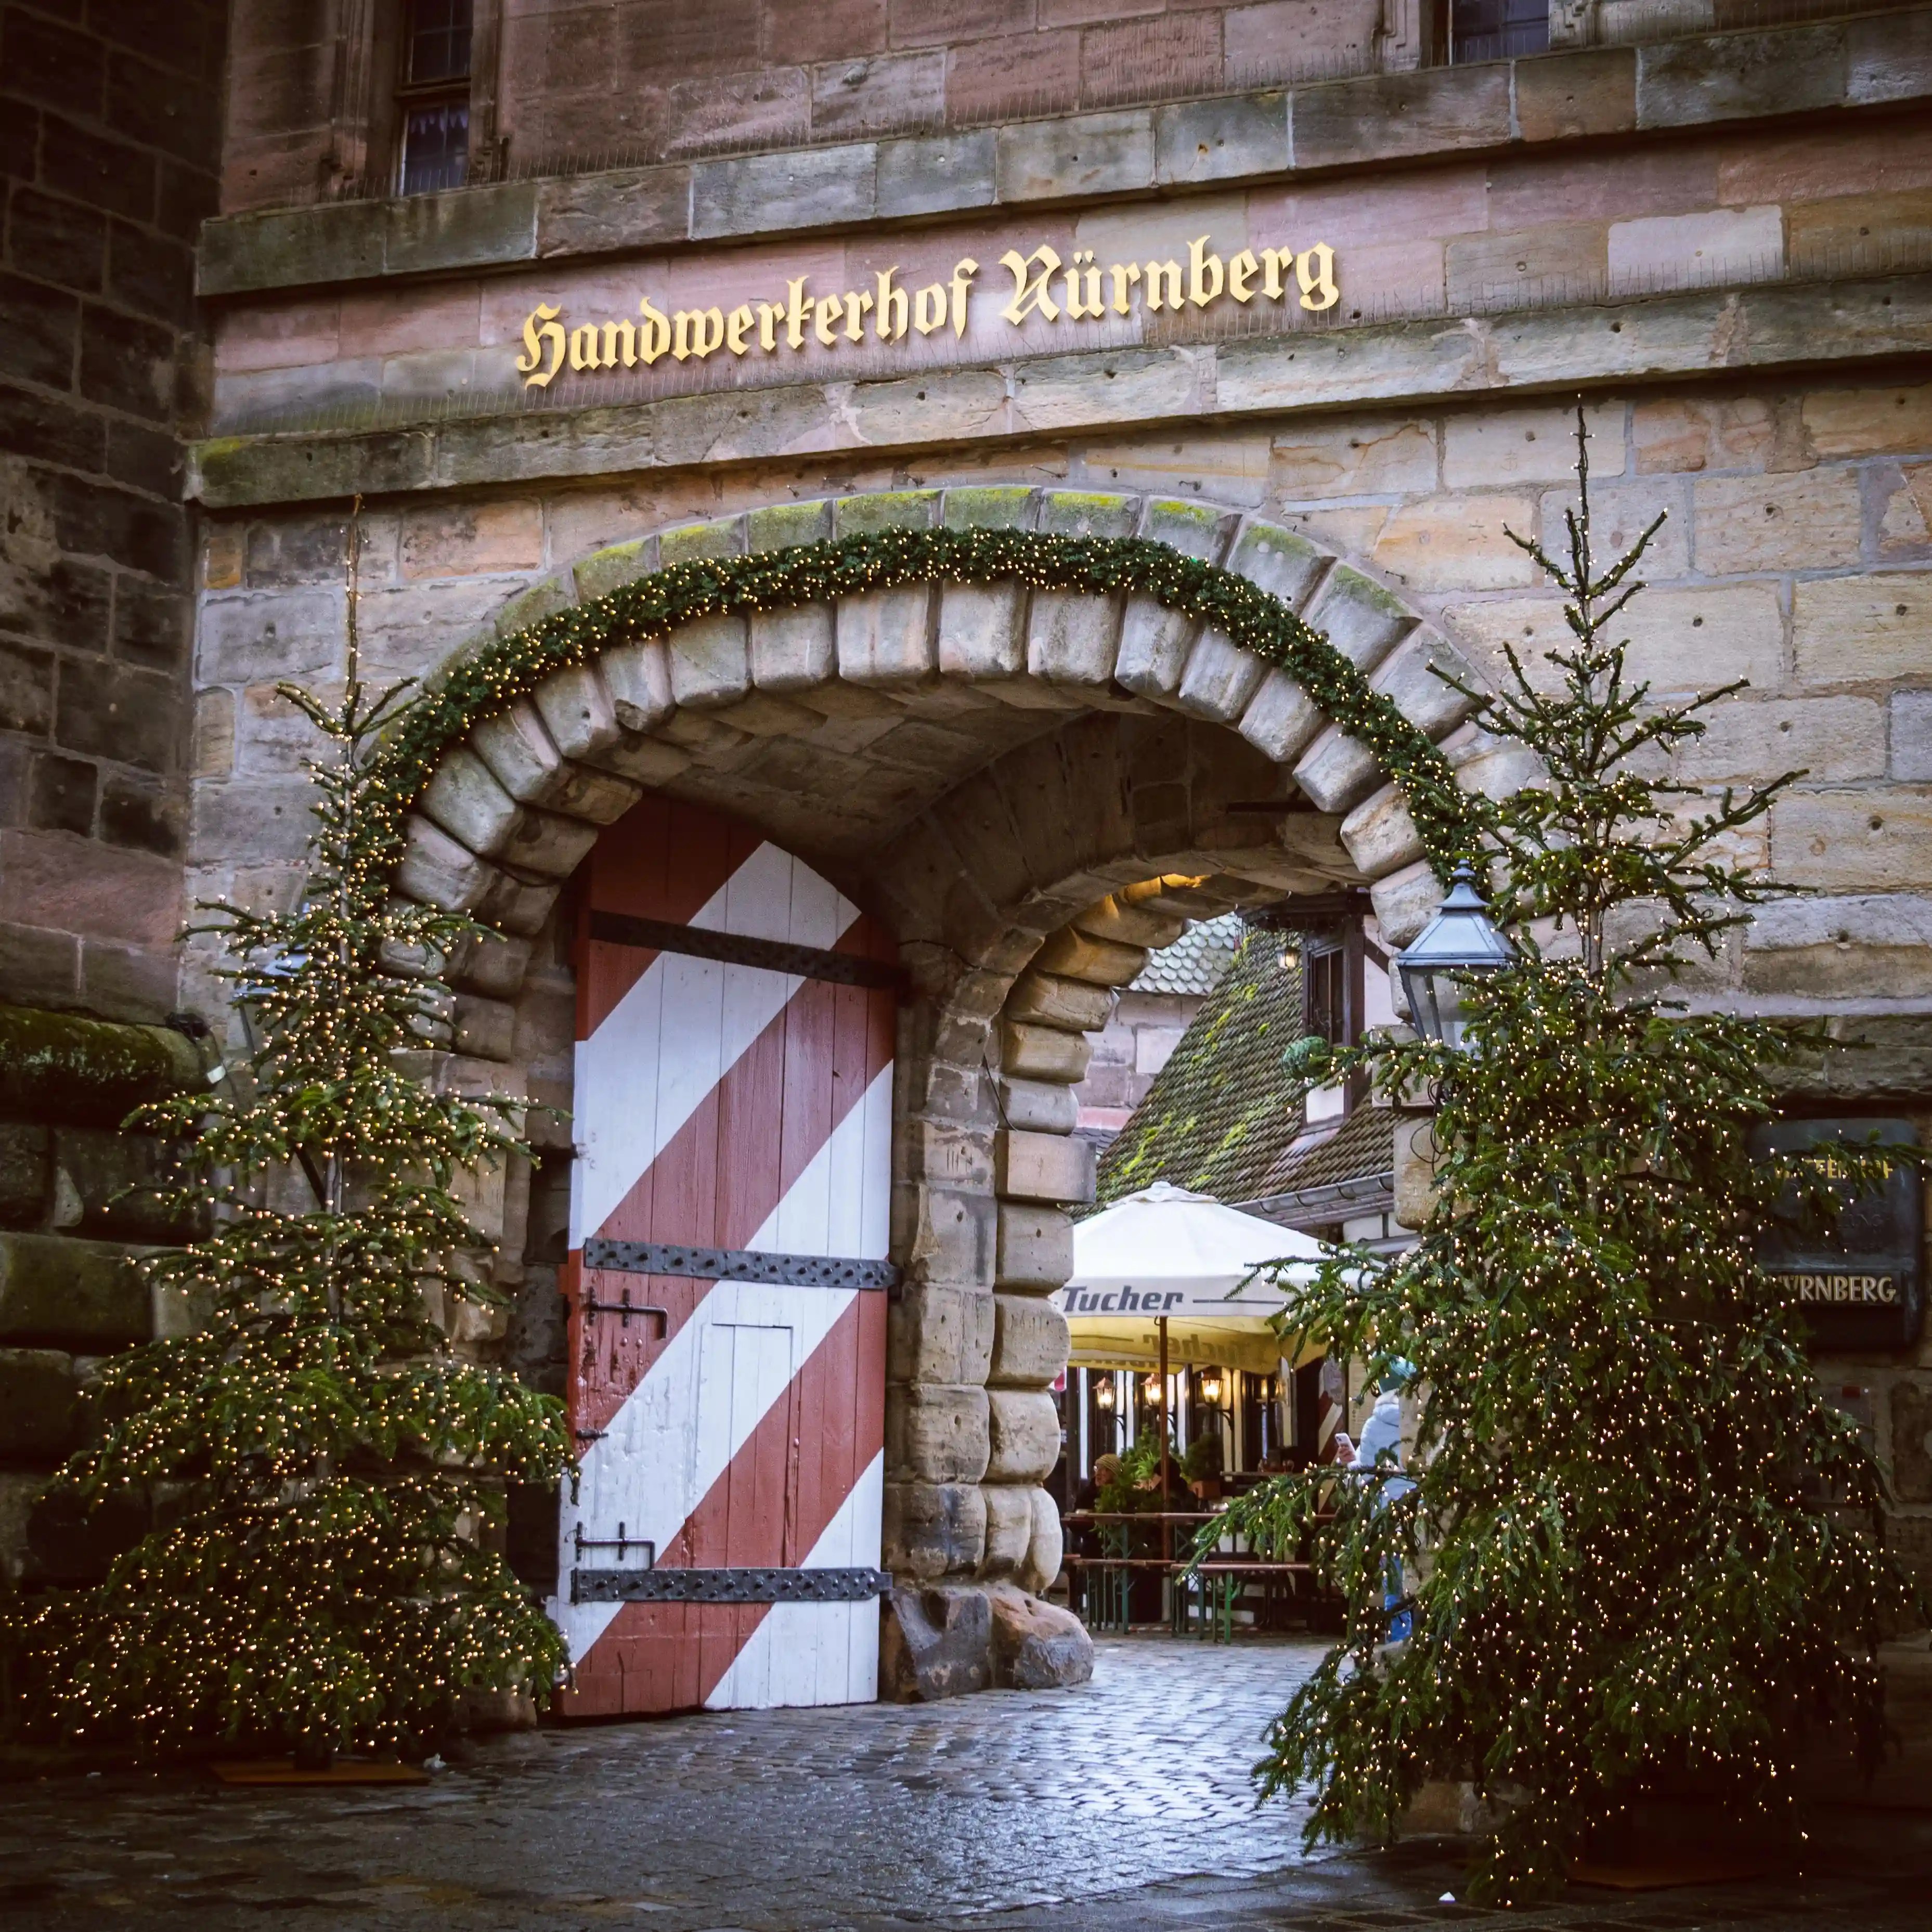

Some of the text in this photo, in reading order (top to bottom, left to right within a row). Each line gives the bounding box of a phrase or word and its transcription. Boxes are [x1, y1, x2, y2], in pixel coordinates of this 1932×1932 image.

[516, 235, 1340, 390] Handwerkerhof Nürnberg
[1062, 1285, 1184, 1312] Tucher
